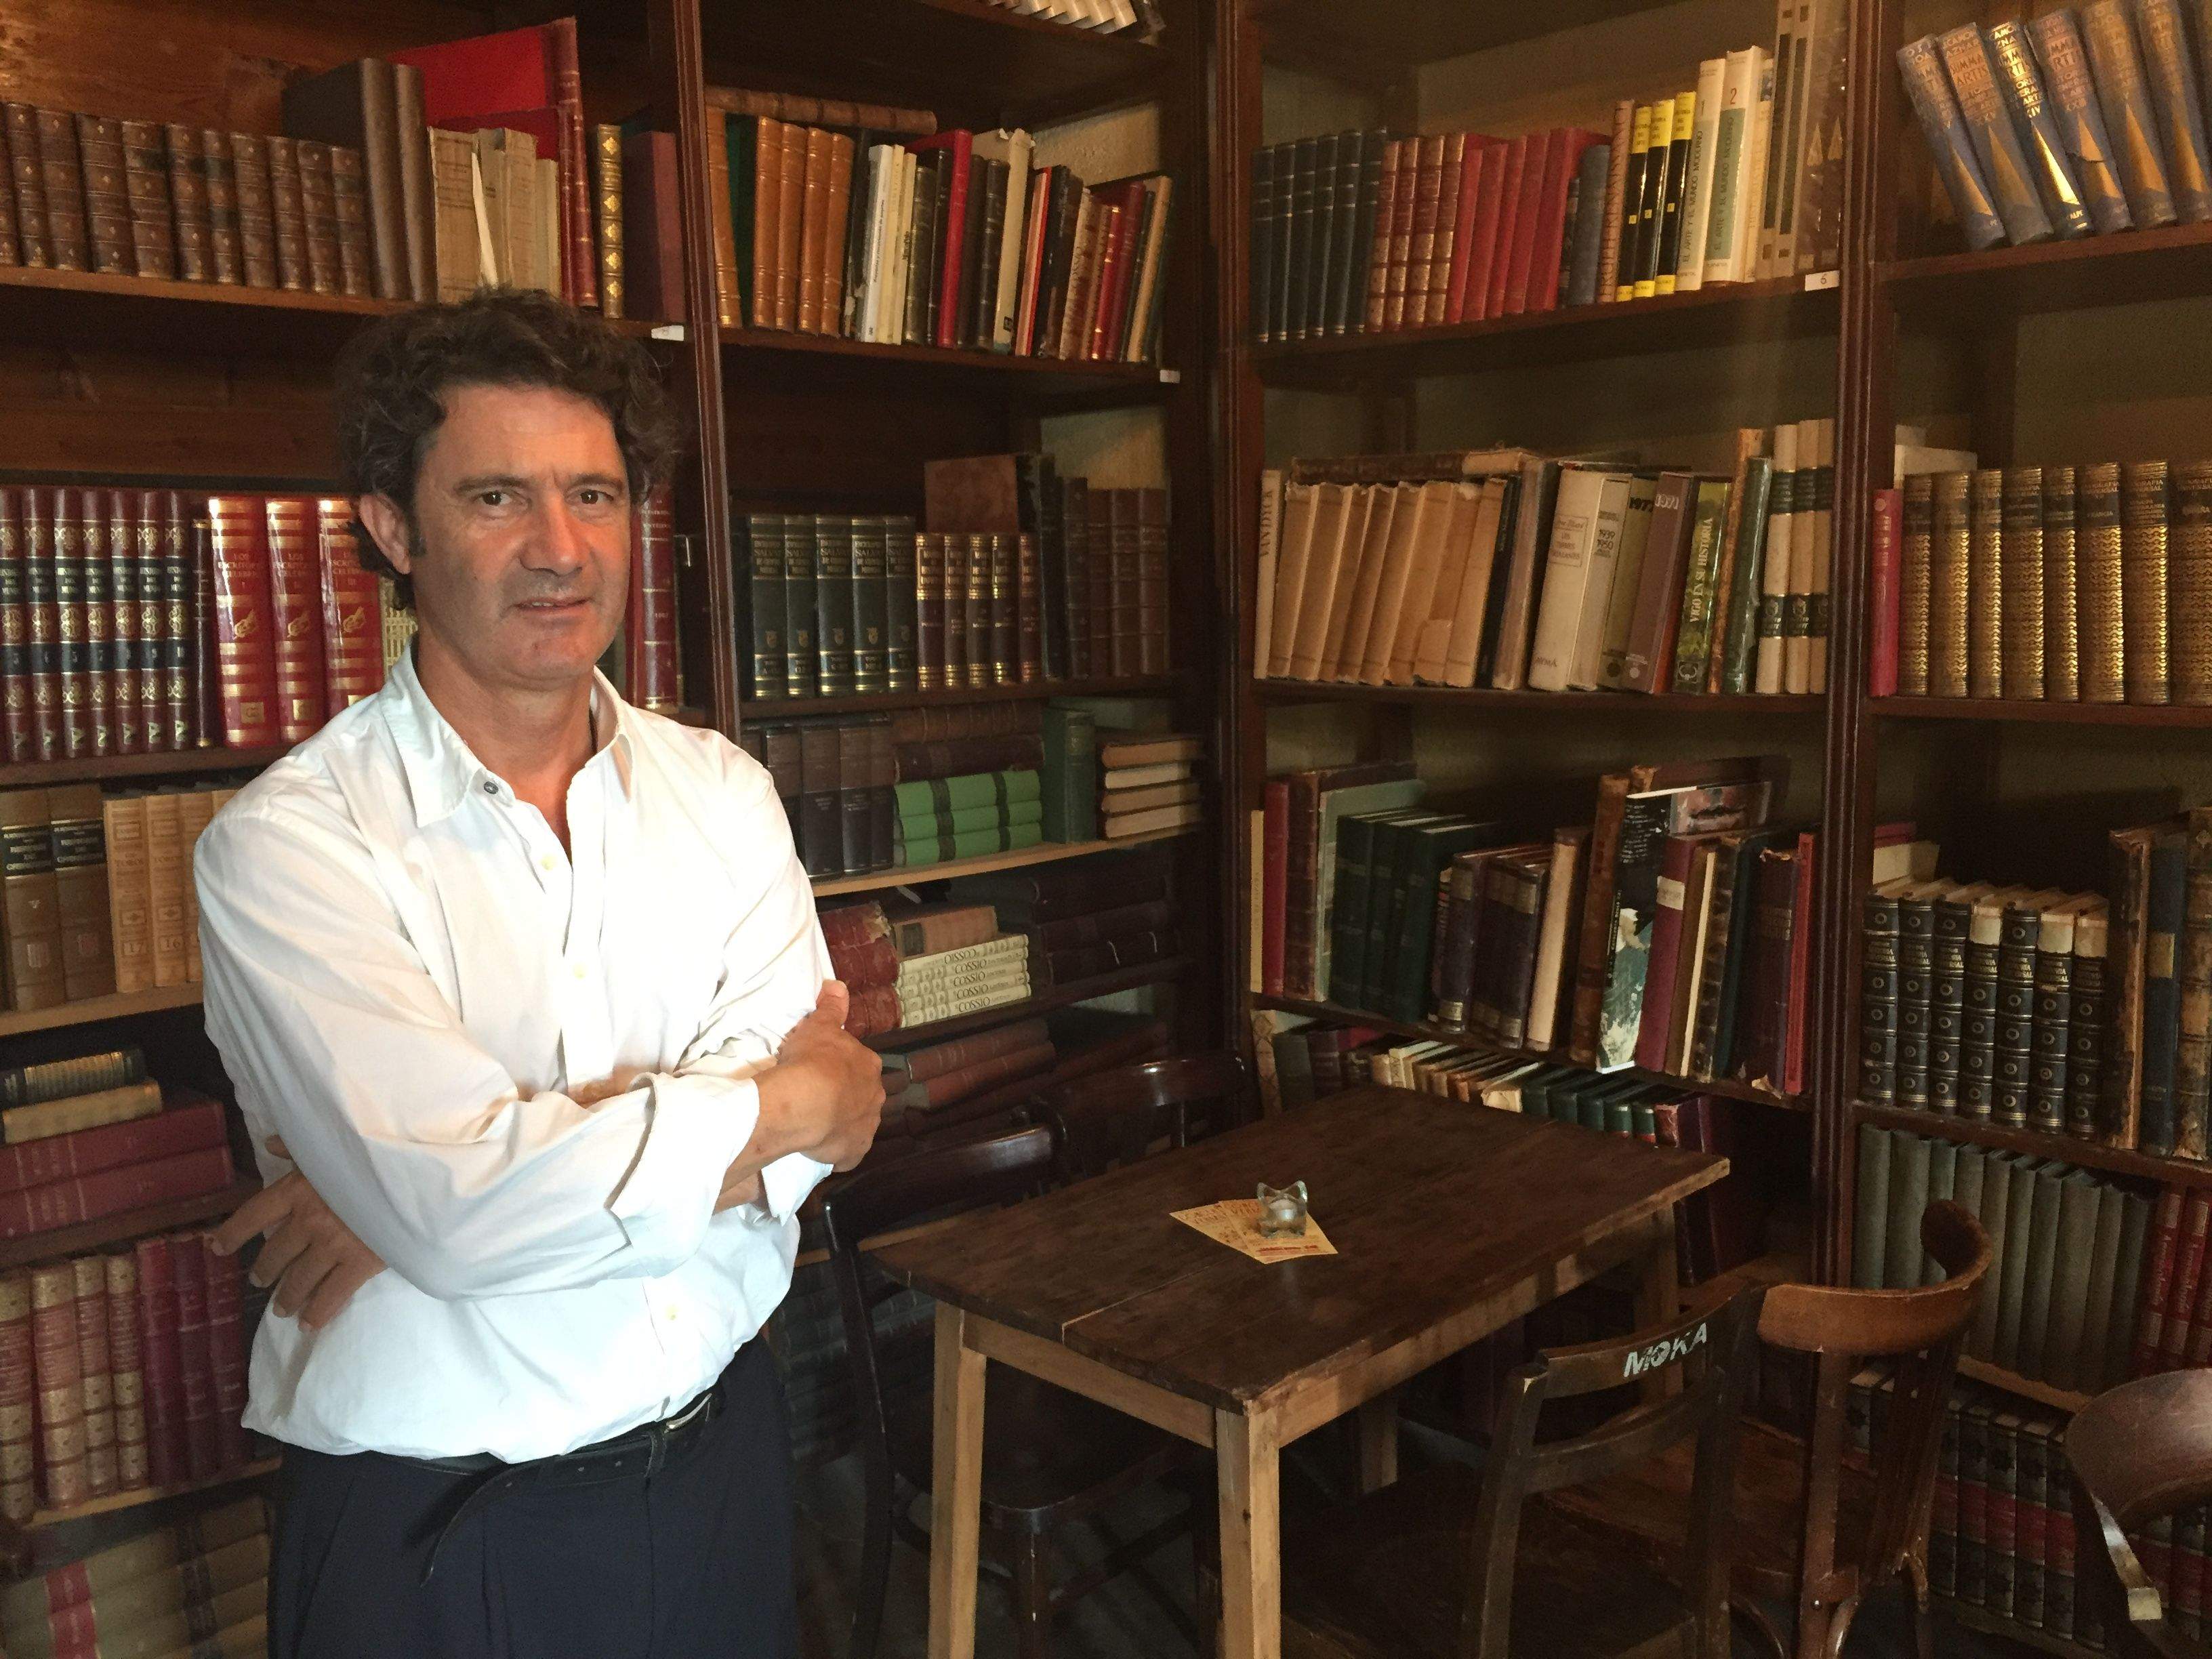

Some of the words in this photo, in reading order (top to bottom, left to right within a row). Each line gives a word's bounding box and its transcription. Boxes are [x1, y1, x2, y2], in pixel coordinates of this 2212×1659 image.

[1729, 87, 1738, 105] 2
[1725, 117, 1735, 159] MODERNO
[1722, 163, 1731, 193] MUNDO
[1682, 254, 1690, 262] EL
[1689, 176, 1698, 207] MUNDO
[1694, 131, 1703, 171] MODERNO
[1715, 218, 1725, 237] ARTE
[1820, 273, 1827, 285] 6
[1655, 494, 1679, 510] 1971
[1599, 529, 1616, 539] 1939
[1698, 517, 1713, 567] HISTORIA
[1597, 539, 1614, 550] 1950
[1696, 568, 1706, 581] SU
